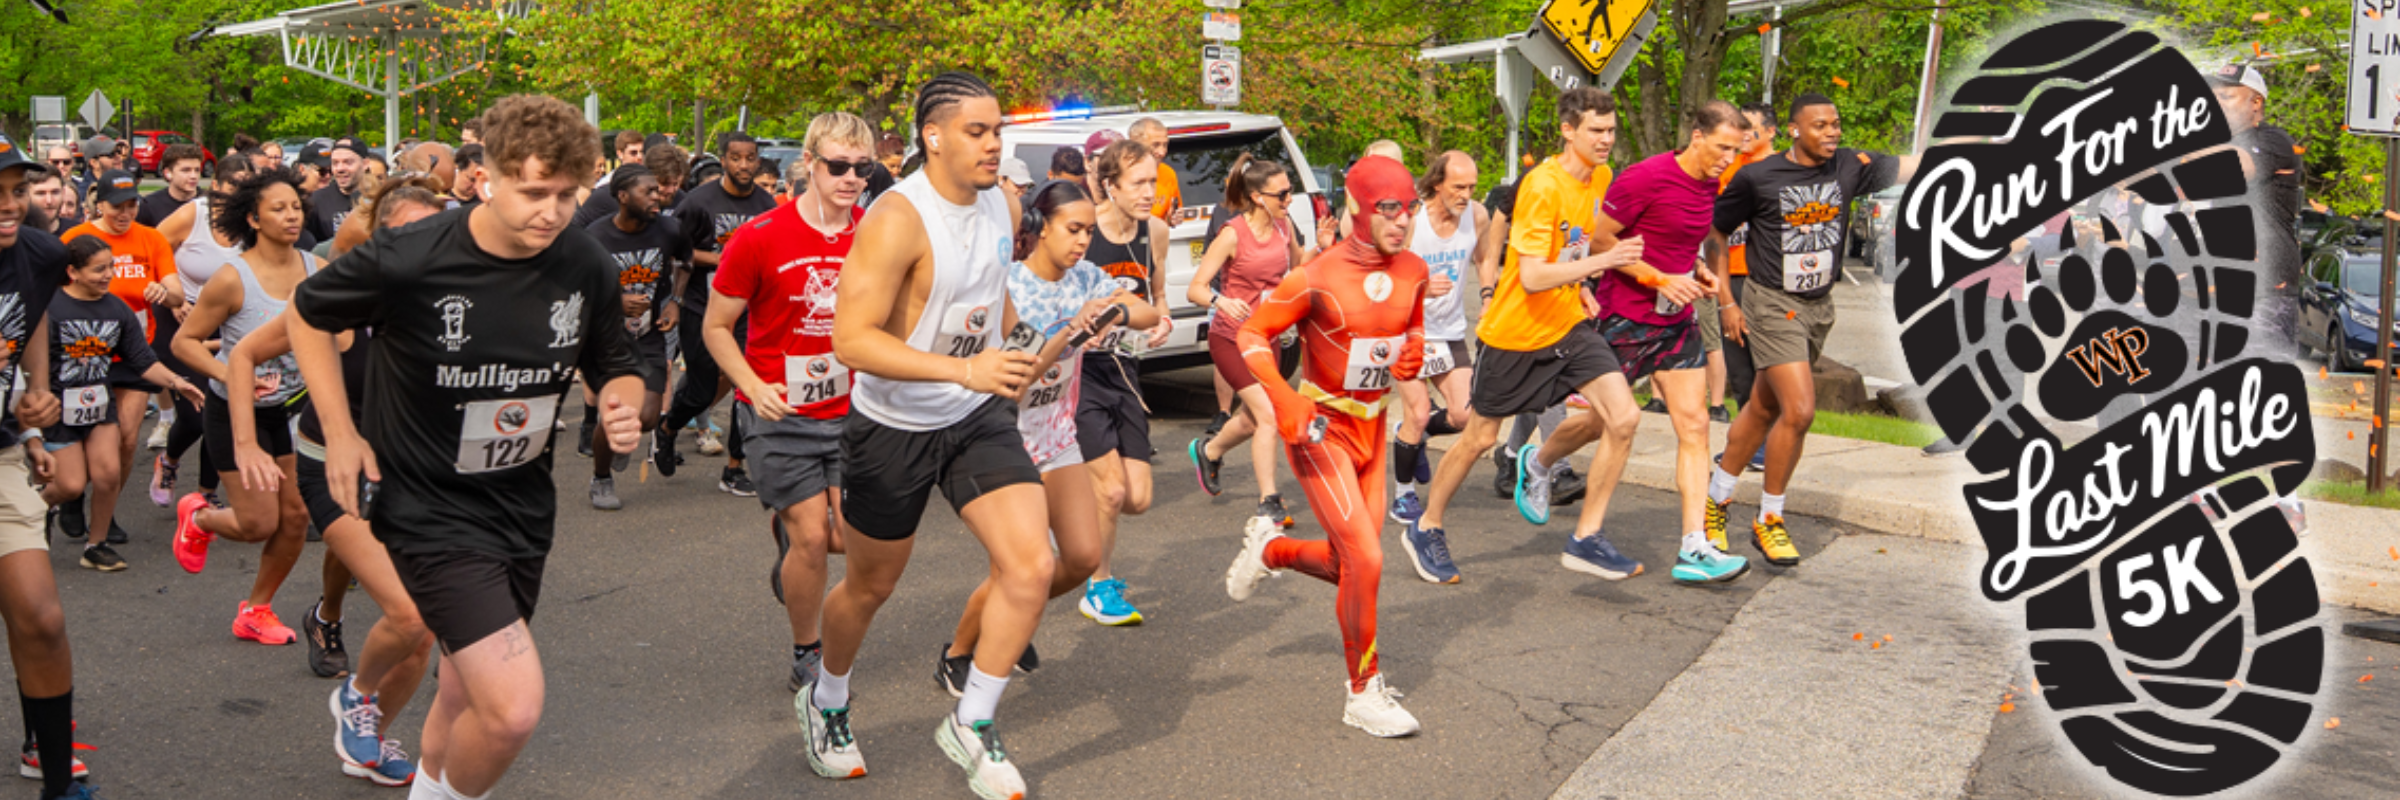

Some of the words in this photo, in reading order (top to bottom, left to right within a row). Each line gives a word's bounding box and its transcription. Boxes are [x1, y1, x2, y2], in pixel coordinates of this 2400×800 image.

[1795, 272, 1822, 290] 237
[947, 335, 986, 358] 204
[436, 361, 573, 392] Mulligan's
[1359, 366, 1390, 389] 276
[1423, 357, 1447, 376] 208
[803, 378, 837, 403] 214
[74, 407, 100, 424] 244
[482, 436, 531, 469] 122
